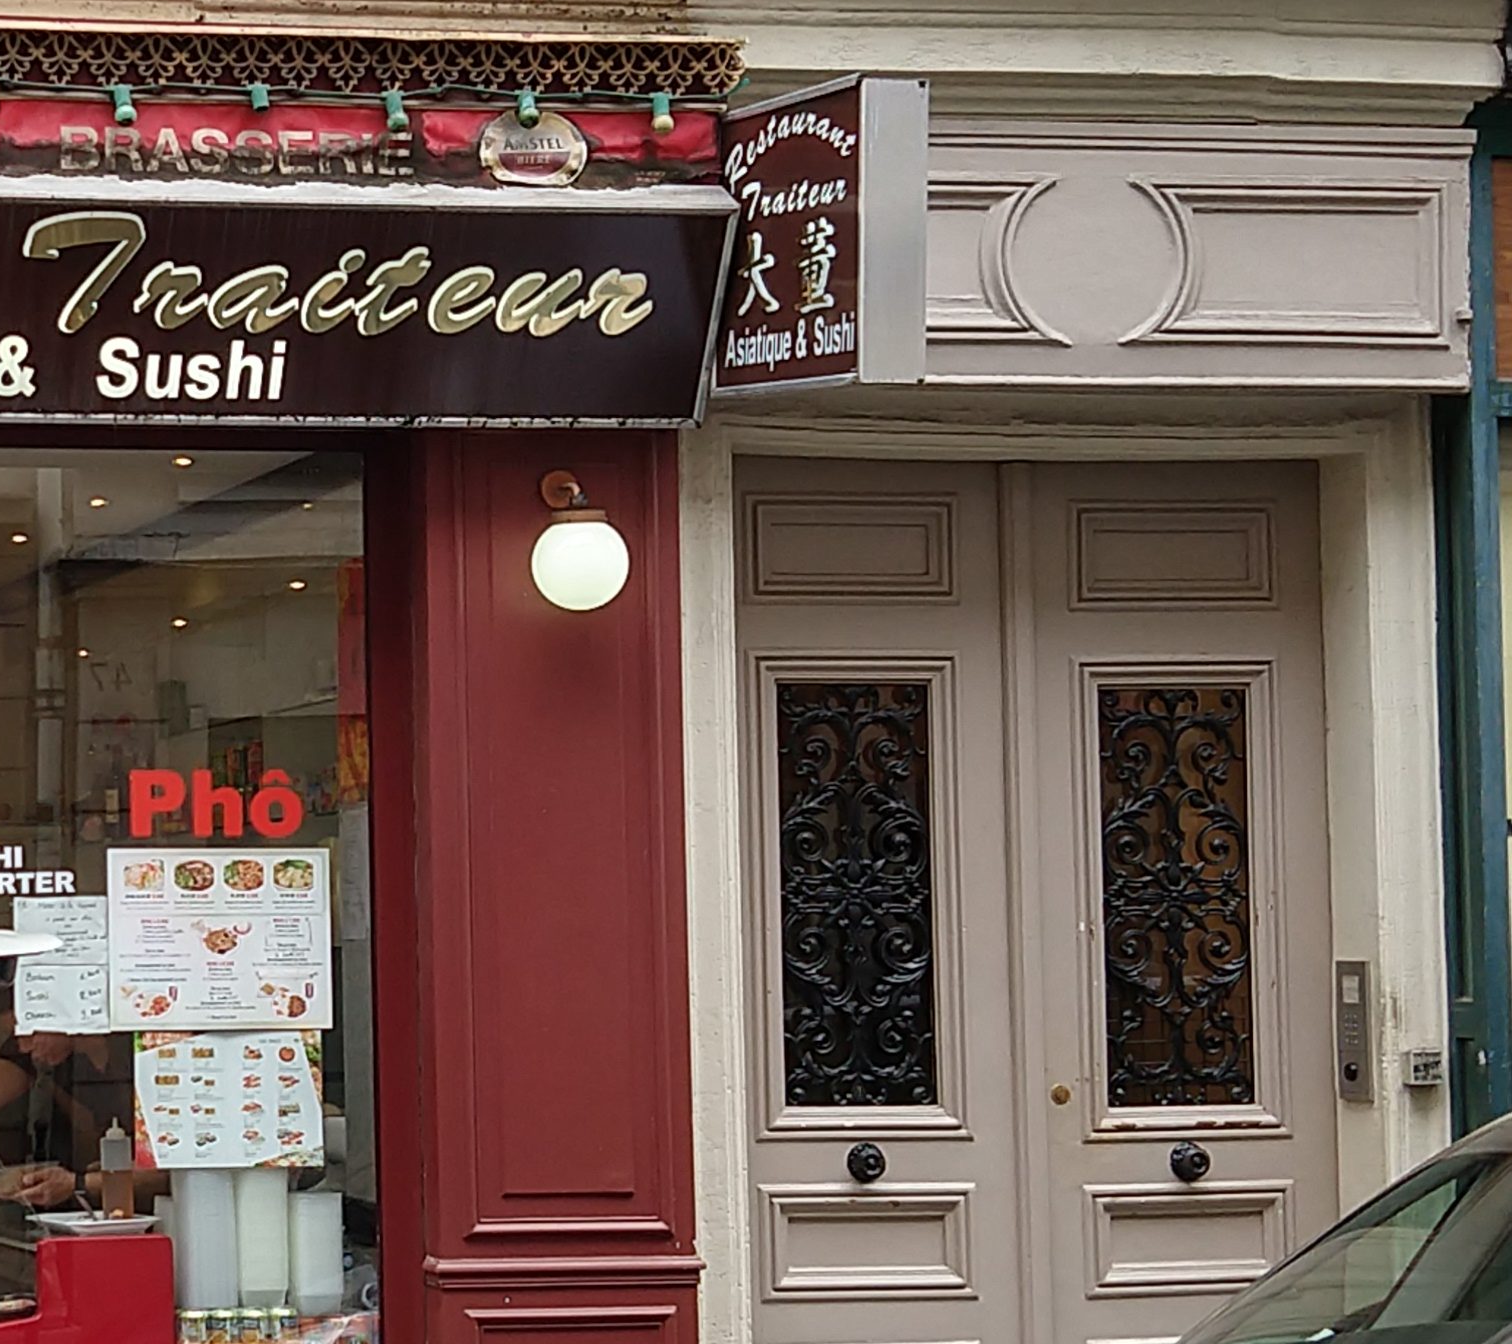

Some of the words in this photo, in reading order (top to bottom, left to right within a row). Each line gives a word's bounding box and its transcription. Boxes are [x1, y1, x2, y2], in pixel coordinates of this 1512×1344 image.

[59, 125, 413, 177] BRASSERIE
[504, 137, 563, 151] AMSTEL
[724, 111, 857, 196] Restaurant
[741, 178, 848, 222] Traiteur
[22, 210, 655, 338] Traiteur
[95, 336, 287, 401] Sushi
[724, 323, 791, 372] Asiatique
[796, 318, 808, 359] &
[813, 311, 856, 356] Sushi
[129, 768, 304, 839] Phô
